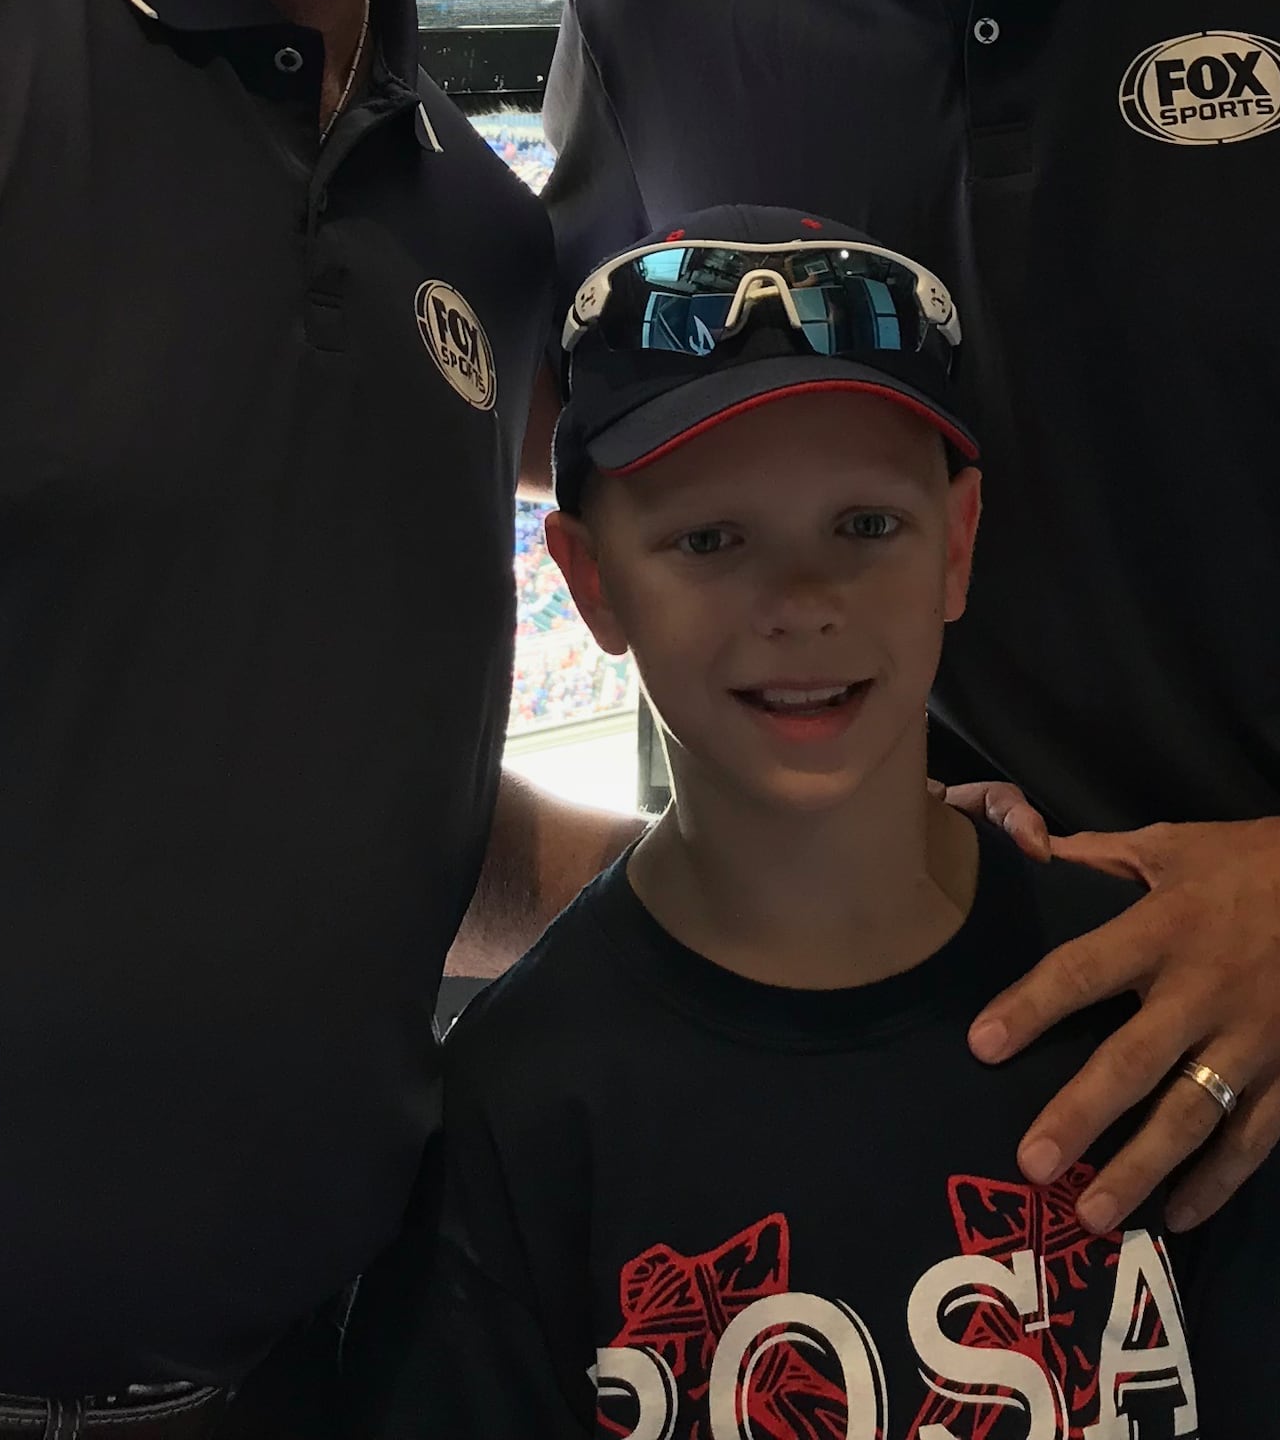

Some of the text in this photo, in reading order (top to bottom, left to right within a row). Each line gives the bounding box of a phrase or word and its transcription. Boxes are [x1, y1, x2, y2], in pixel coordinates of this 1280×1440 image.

[1154, 51, 1271, 107] FOX
[1159, 98, 1275, 126] SPORTS
[431, 295, 482, 375] FOX
[441, 345, 487, 394] SPORTS
